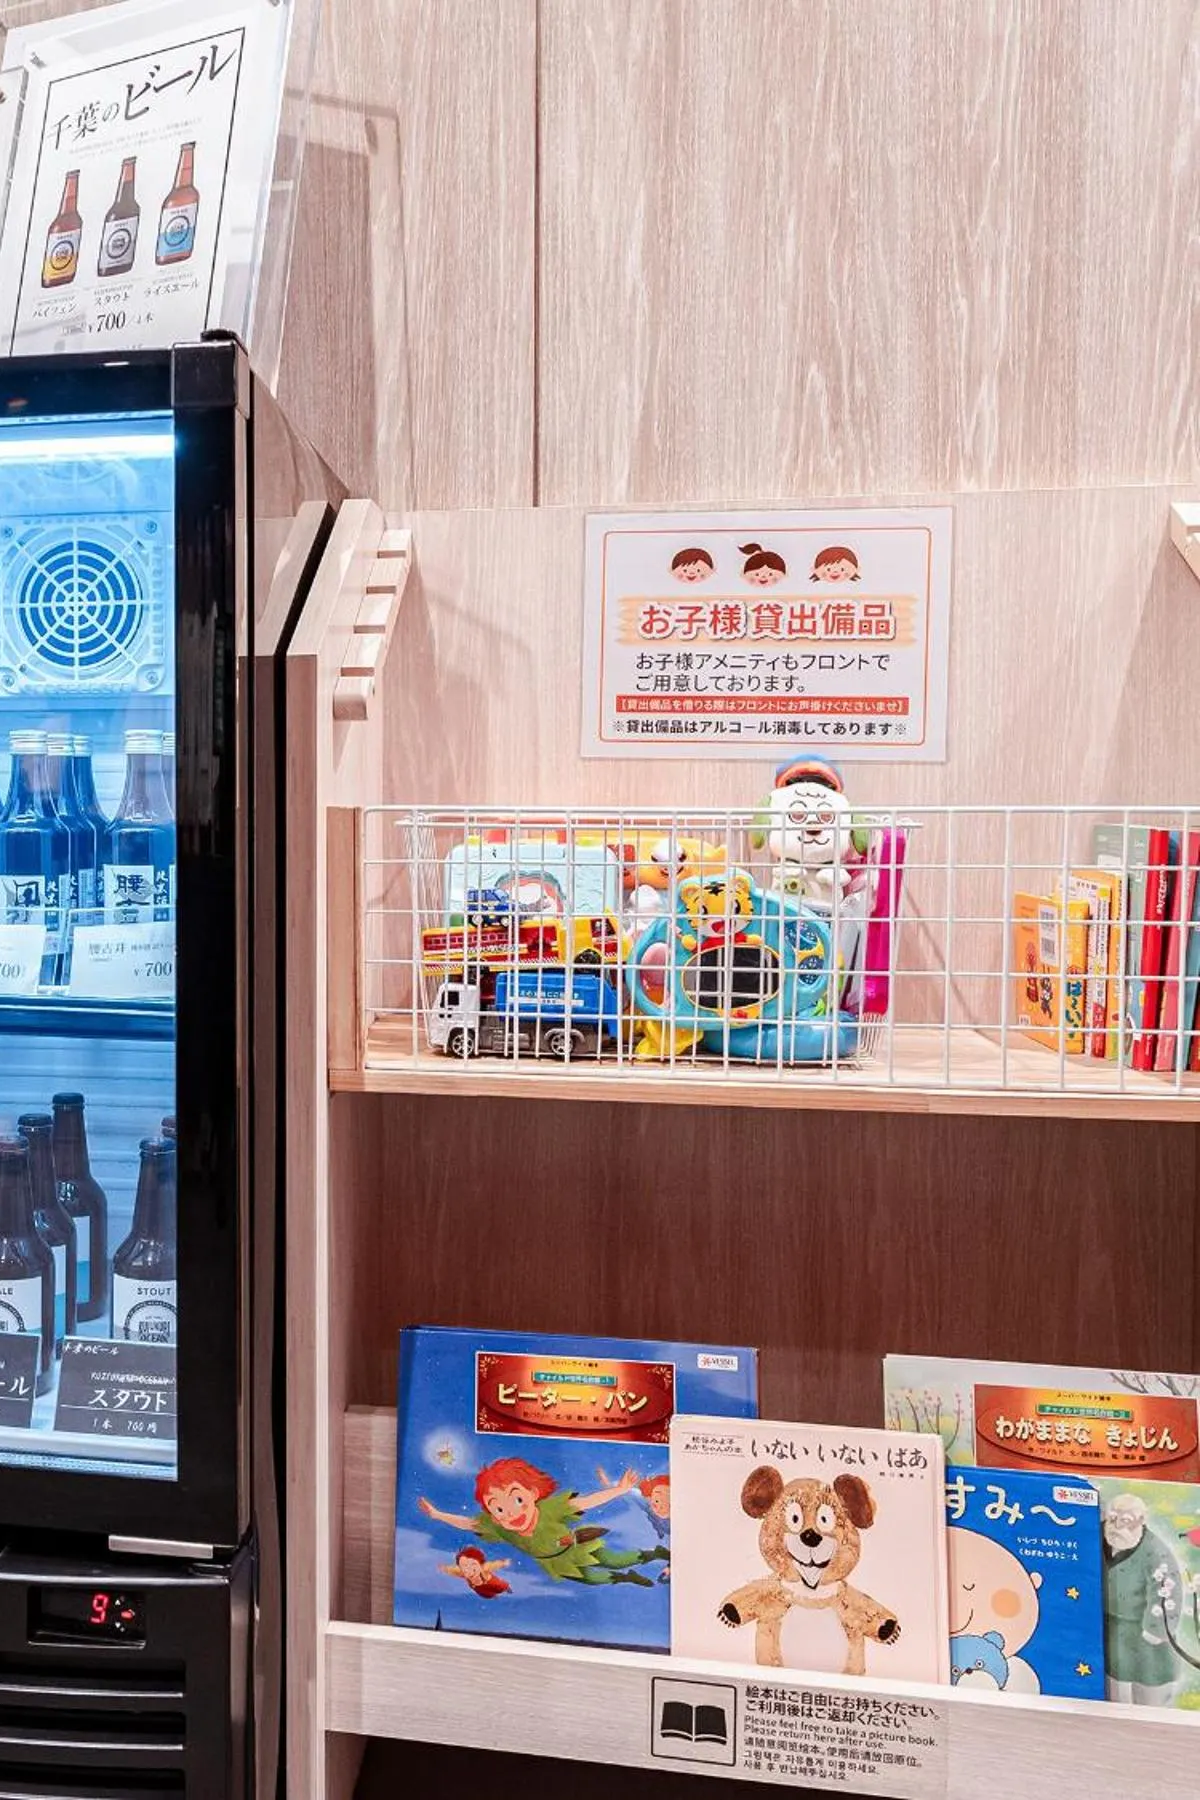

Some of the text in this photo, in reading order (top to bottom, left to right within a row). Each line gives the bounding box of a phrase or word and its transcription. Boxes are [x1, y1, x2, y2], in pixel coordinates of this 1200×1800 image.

[48, 45, 236, 150] 千葉のビール
[640, 603, 892, 637] お子様貸出備品
[635, 652, 890, 672] お子様アメニティもフロントで
[635, 674, 806, 693] ご用意しております。
[137, 1287, 172, 1296] STOUT
[88, 1389, 168, 1413] スタウト
[497, 1382, 648, 1413] ピーター・パン
[996, 1416, 1179, 1451] わがままな きょじん
[751, 1439, 928, 1469] いない いない ばあ
[91, 1594, 108, 1623] 9
[745, 1685, 940, 1721] 絵本はご自由にお持ちください。
[746, 1701, 912, 1730] ご利用後はご返却ください。
[744, 1715, 777, 1728] Please
[779, 1718, 797, 1730] feel
[801, 1721, 820, 1733] free
[823, 1725, 833, 1734] to
[836, 1725, 858, 1737] take
[869, 1729, 906, 1743] picture
[909, 1735, 938, 1748] book.
[744, 1724, 886, 1750] Please return here after use.
